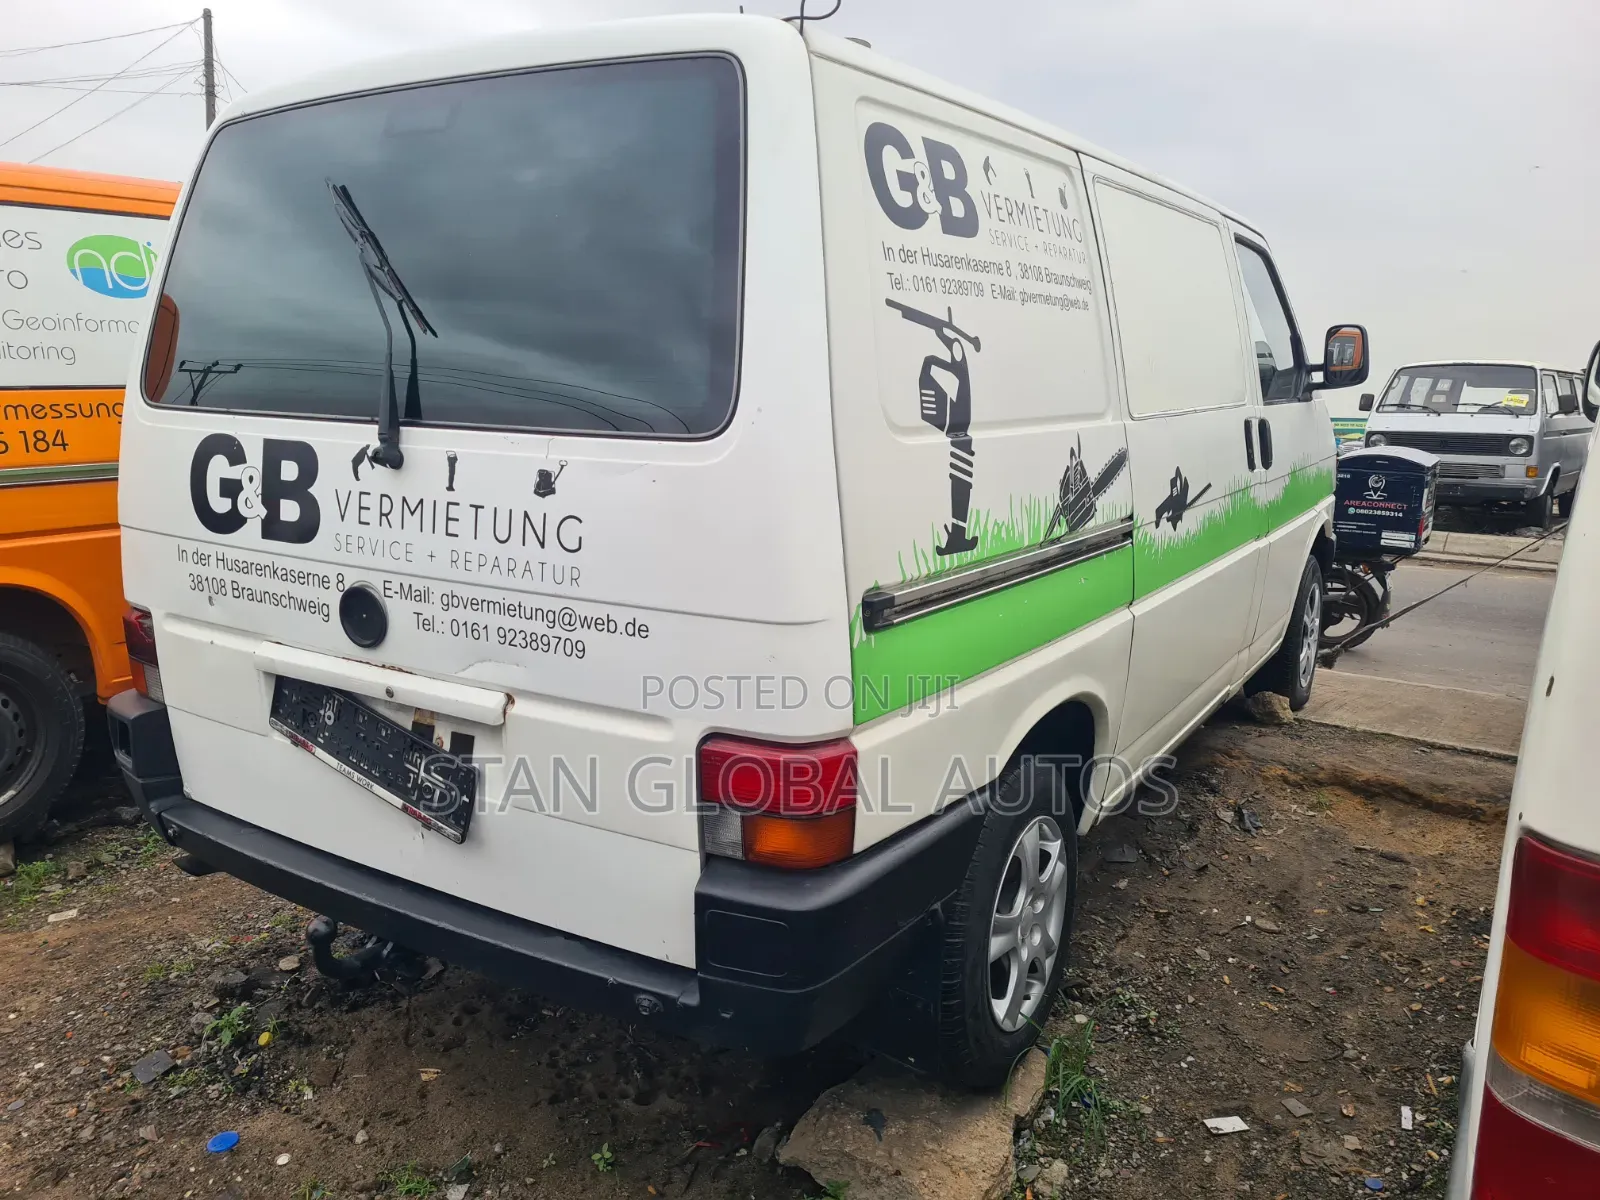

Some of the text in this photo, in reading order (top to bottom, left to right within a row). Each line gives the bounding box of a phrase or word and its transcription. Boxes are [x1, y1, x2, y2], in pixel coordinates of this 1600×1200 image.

[864, 121, 980, 238] G&B
[0, 229, 42, 250] es
[981, 189, 1083, 244] VERMIETUNG
[882, 240, 896, 262] In
[898, 243, 918, 265] der
[920, 246, 1004, 276] Husarenkaserne
[1044, 267, 1093, 296] Braunschweig
[989, 228, 1030, 252] SERVICE
[1043, 241, 1087, 265] REPARATUR
[912, 274, 938, 293] 0161
[939, 278, 985, 298] 92389709
[1018, 288, 1090, 312] gbvermietung@web.de
[0, 341, 76, 366] itoring
[0, 402, 125, 425] messung
[18, 429, 70, 454] 184
[190, 433, 321, 545] G&B
[1343, 499, 1409, 511] AREACONNECT
[334, 488, 583, 554] VERMIETUNG
[177, 543, 346, 593] In der Husarenkaserne 8
[333, 532, 415, 563] SERVICE
[450, 549, 582, 588] REPARATUR
[188, 573, 331, 623] 38108 Braunschweig
[382, 579, 650, 640] E-Mail: gbvermietung@web.de
[412, 611, 586, 660] Tel.: 0161 92389709
[336, 761, 375, 791] TEAMS WORK
